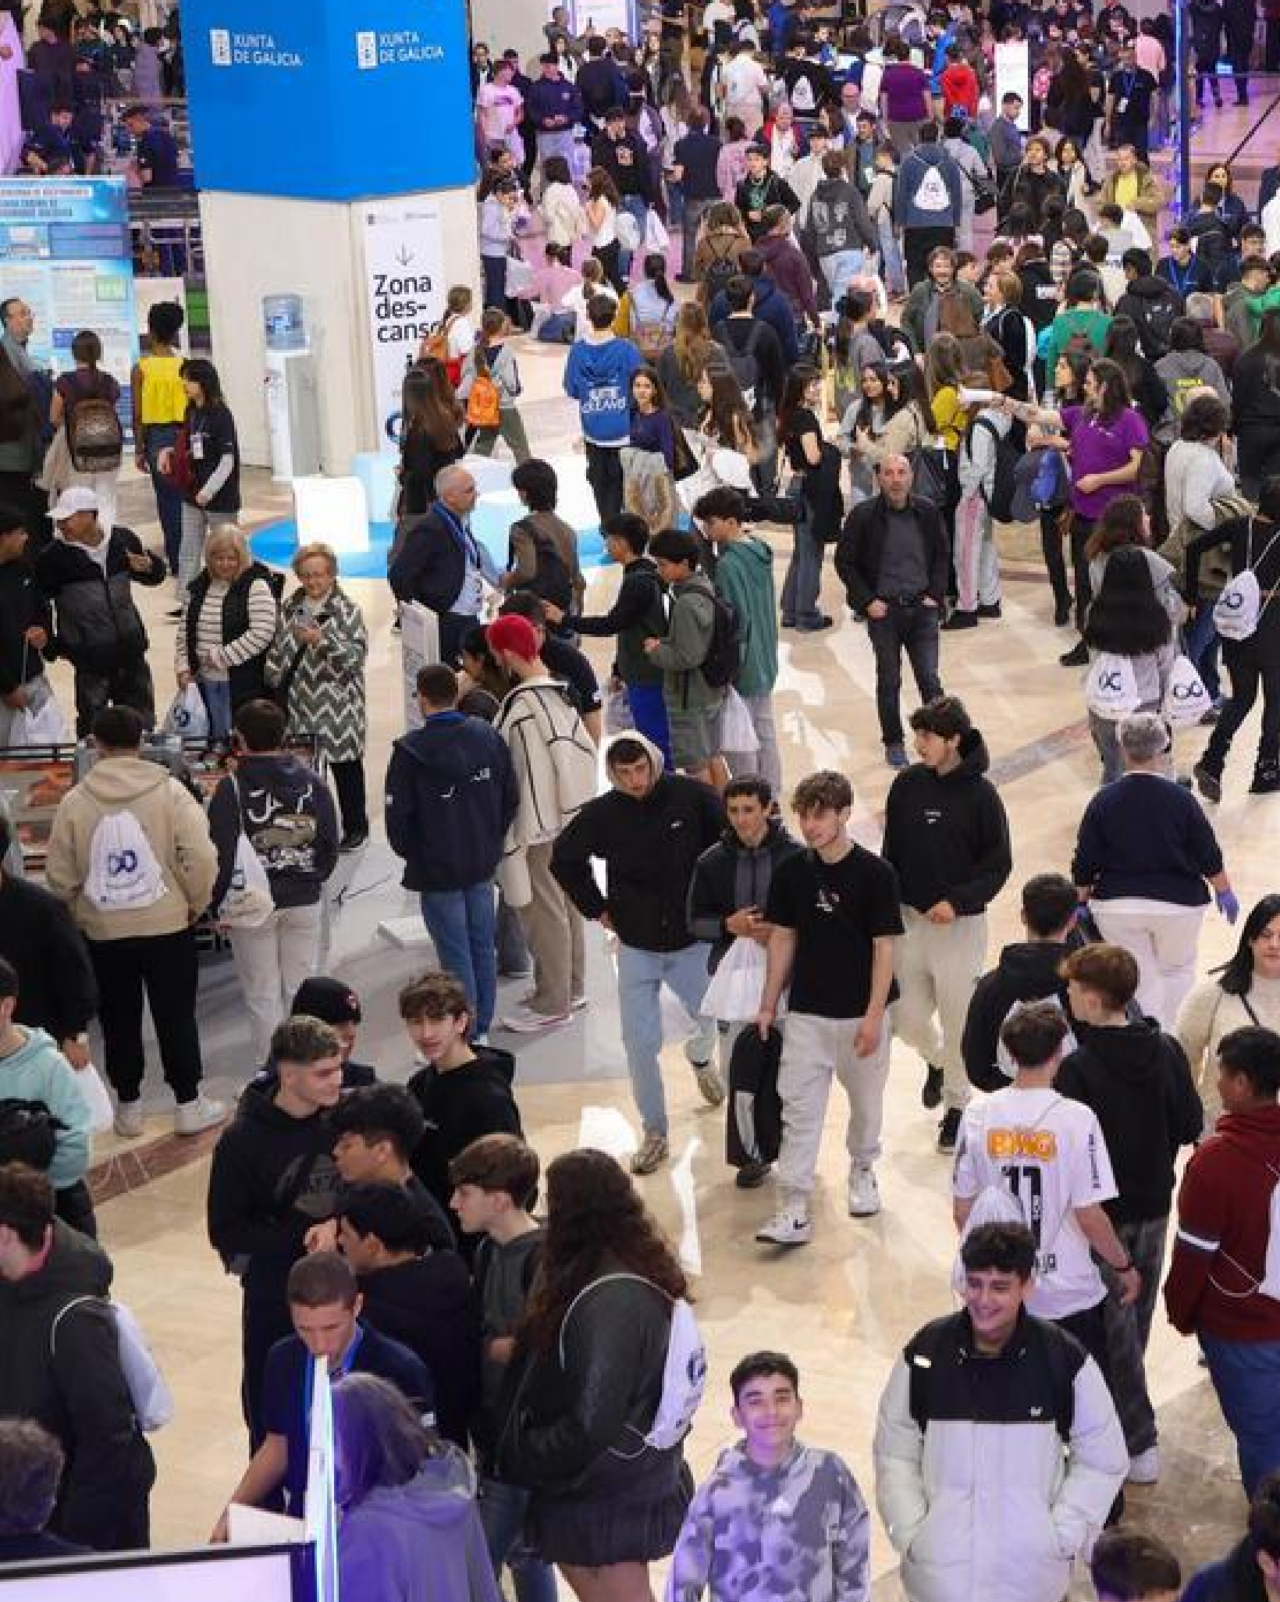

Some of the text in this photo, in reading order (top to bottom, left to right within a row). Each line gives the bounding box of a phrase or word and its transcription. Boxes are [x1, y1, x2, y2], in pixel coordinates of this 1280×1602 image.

[233, 34, 275, 49] XUNTA
[378, 31, 420, 48] XUNTA
[233, 49, 303, 66] DE GALICIA
[379, 46, 445, 64] DE GALICIA
[373, 274, 432, 296] Zona
[375, 295, 427, 319] des-
